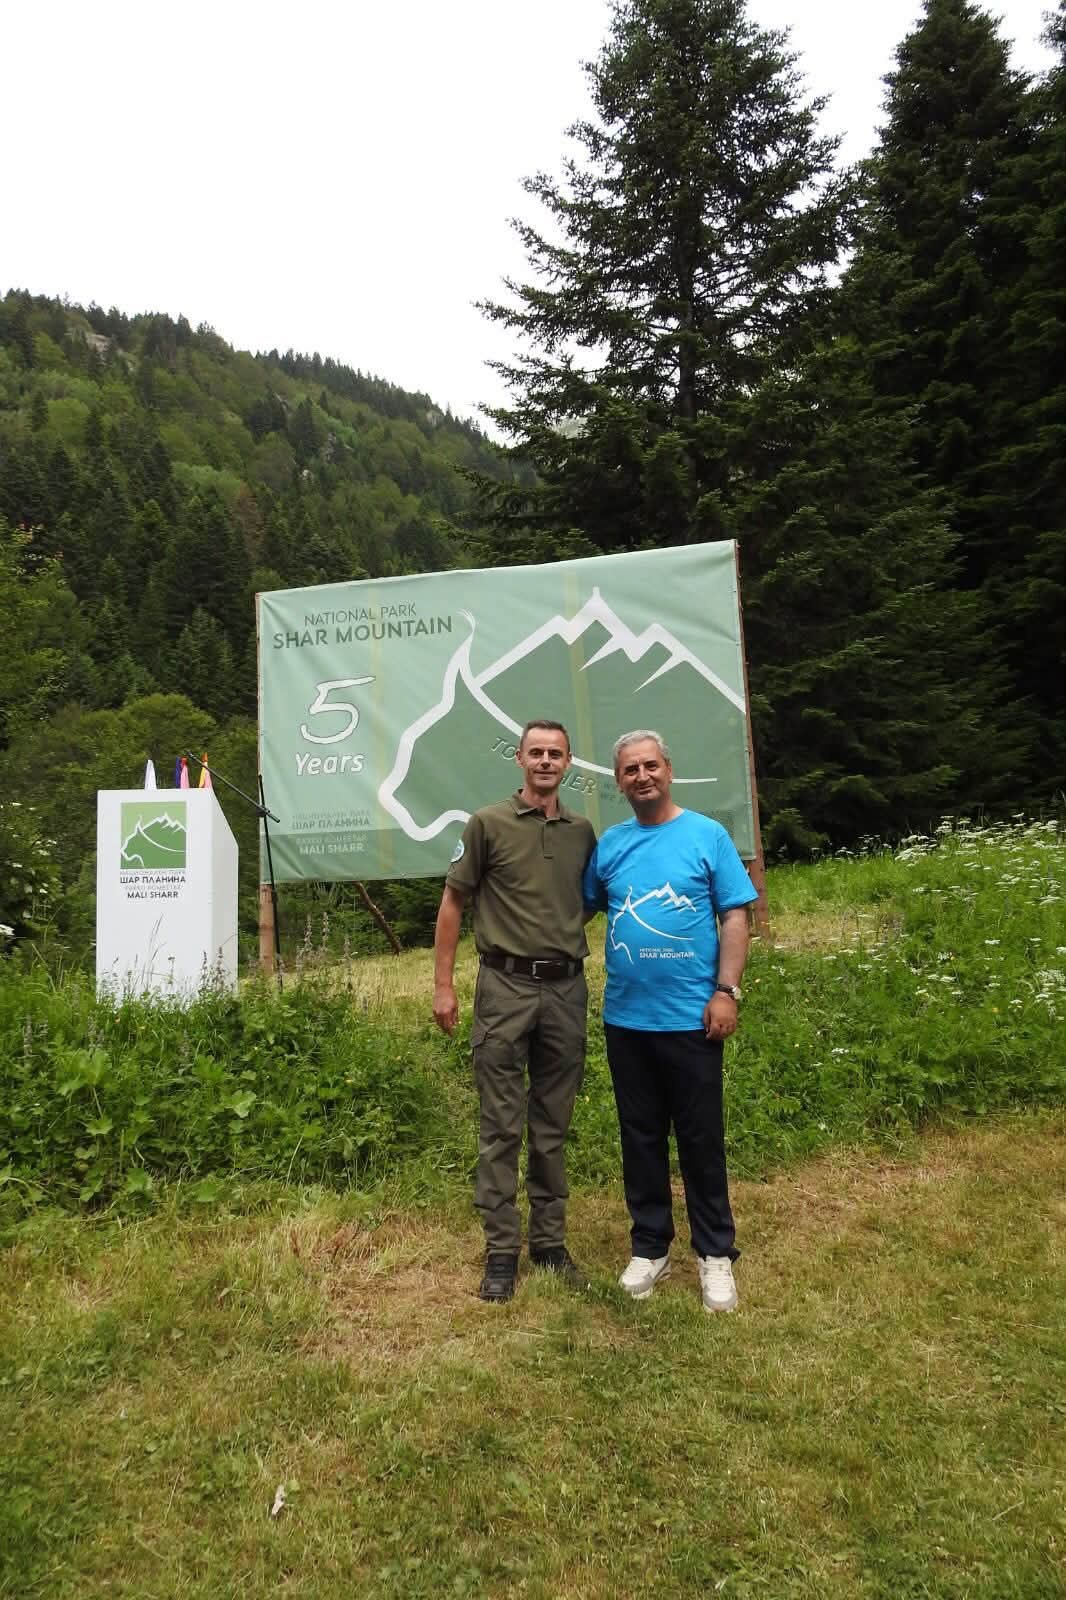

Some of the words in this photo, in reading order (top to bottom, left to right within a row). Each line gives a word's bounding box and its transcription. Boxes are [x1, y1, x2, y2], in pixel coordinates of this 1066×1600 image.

[304, 608, 376, 626] NATIONAL
[381, 602, 417, 618] PARK
[273, 629, 328, 649] SHAR
[336, 616, 453, 643] MOUNTAIN
[300, 675, 376, 744] 5
[295, 752, 365, 776] Years
[120, 876, 140, 884] ШАР
